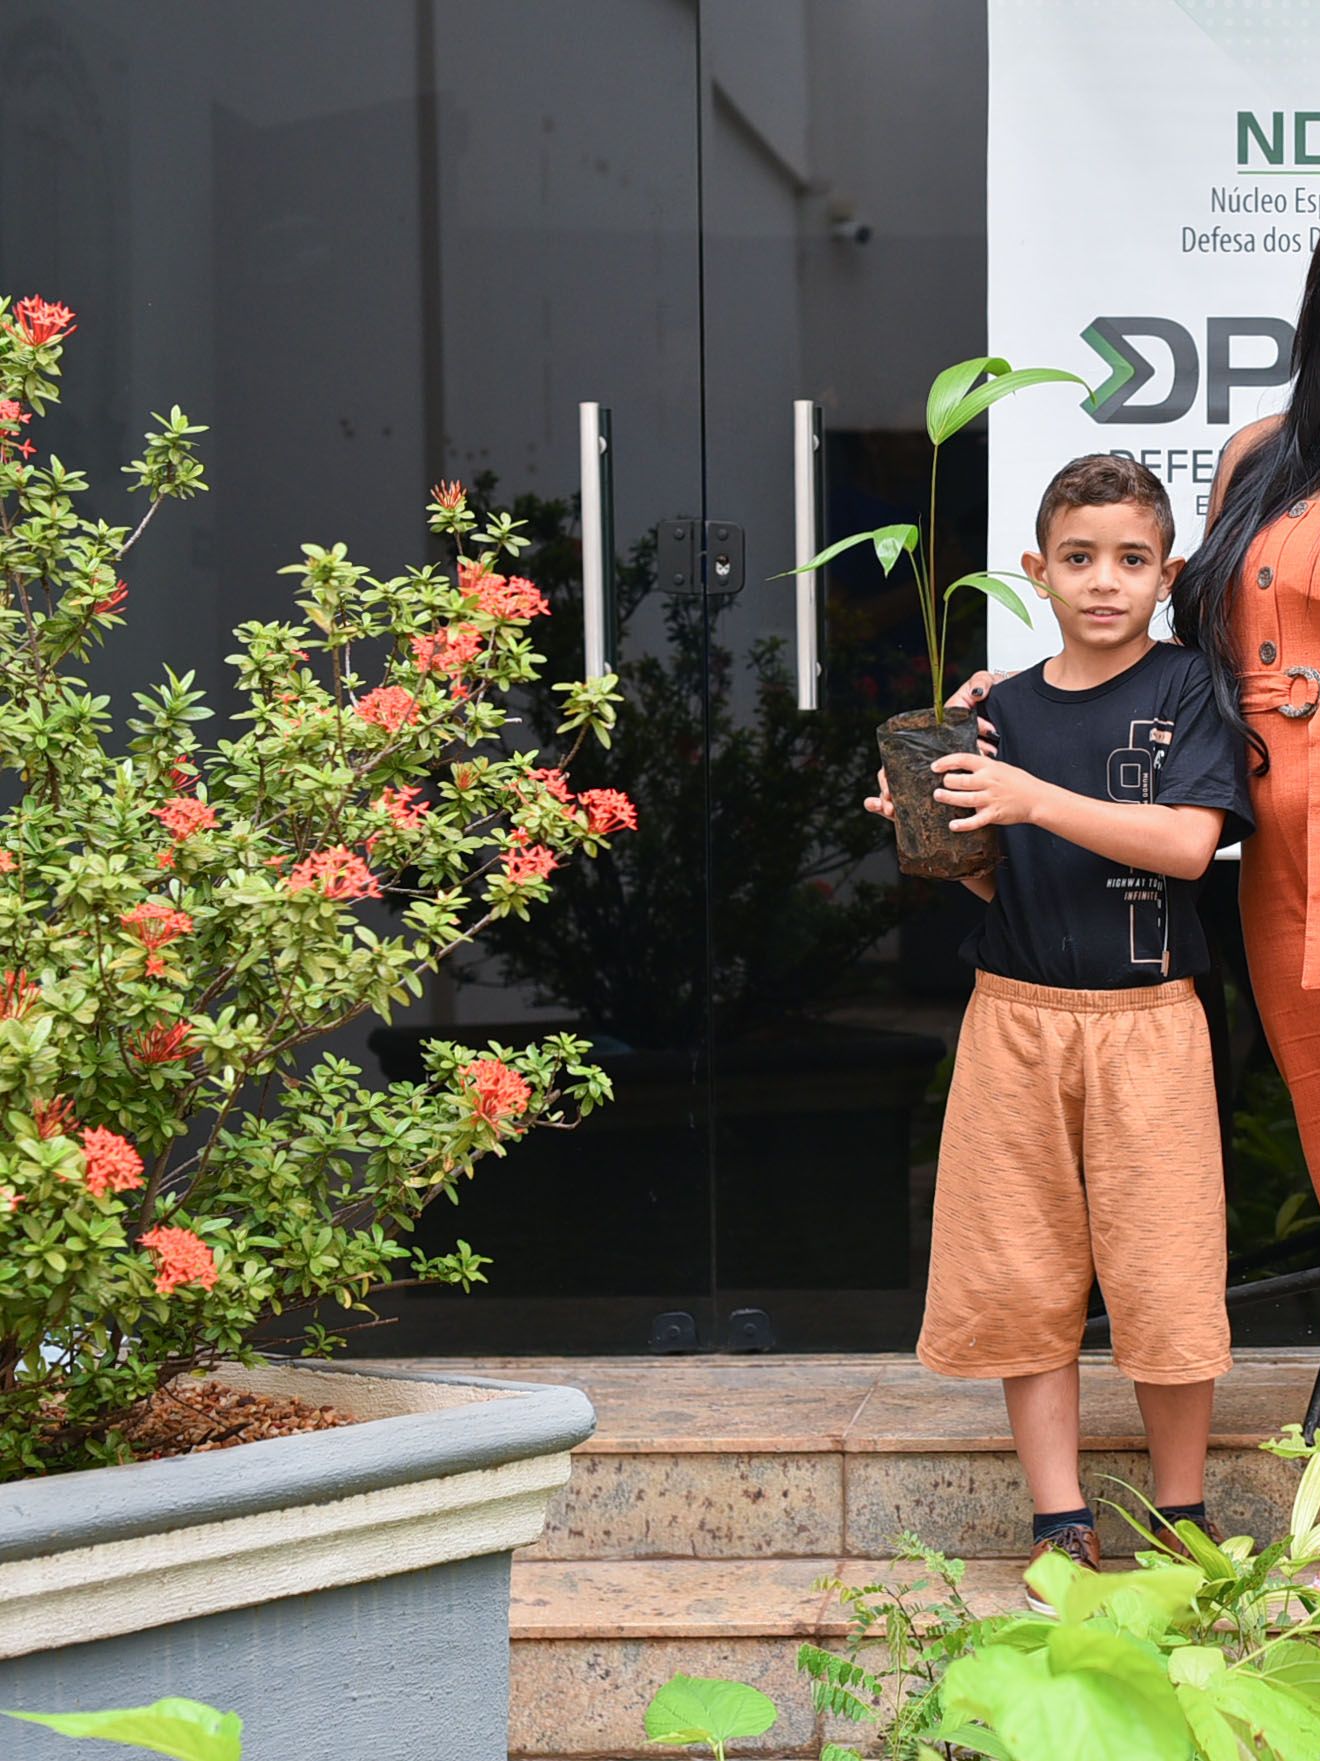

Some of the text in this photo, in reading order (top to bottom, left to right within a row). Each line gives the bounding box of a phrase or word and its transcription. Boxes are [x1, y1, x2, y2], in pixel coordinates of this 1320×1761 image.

[1211, 186, 1288, 214] Núcleo
[1181, 226, 1256, 253] Defesa
[1262, 226, 1302, 253] dos
[1105, 877, 1146, 889] HIGHWAY
